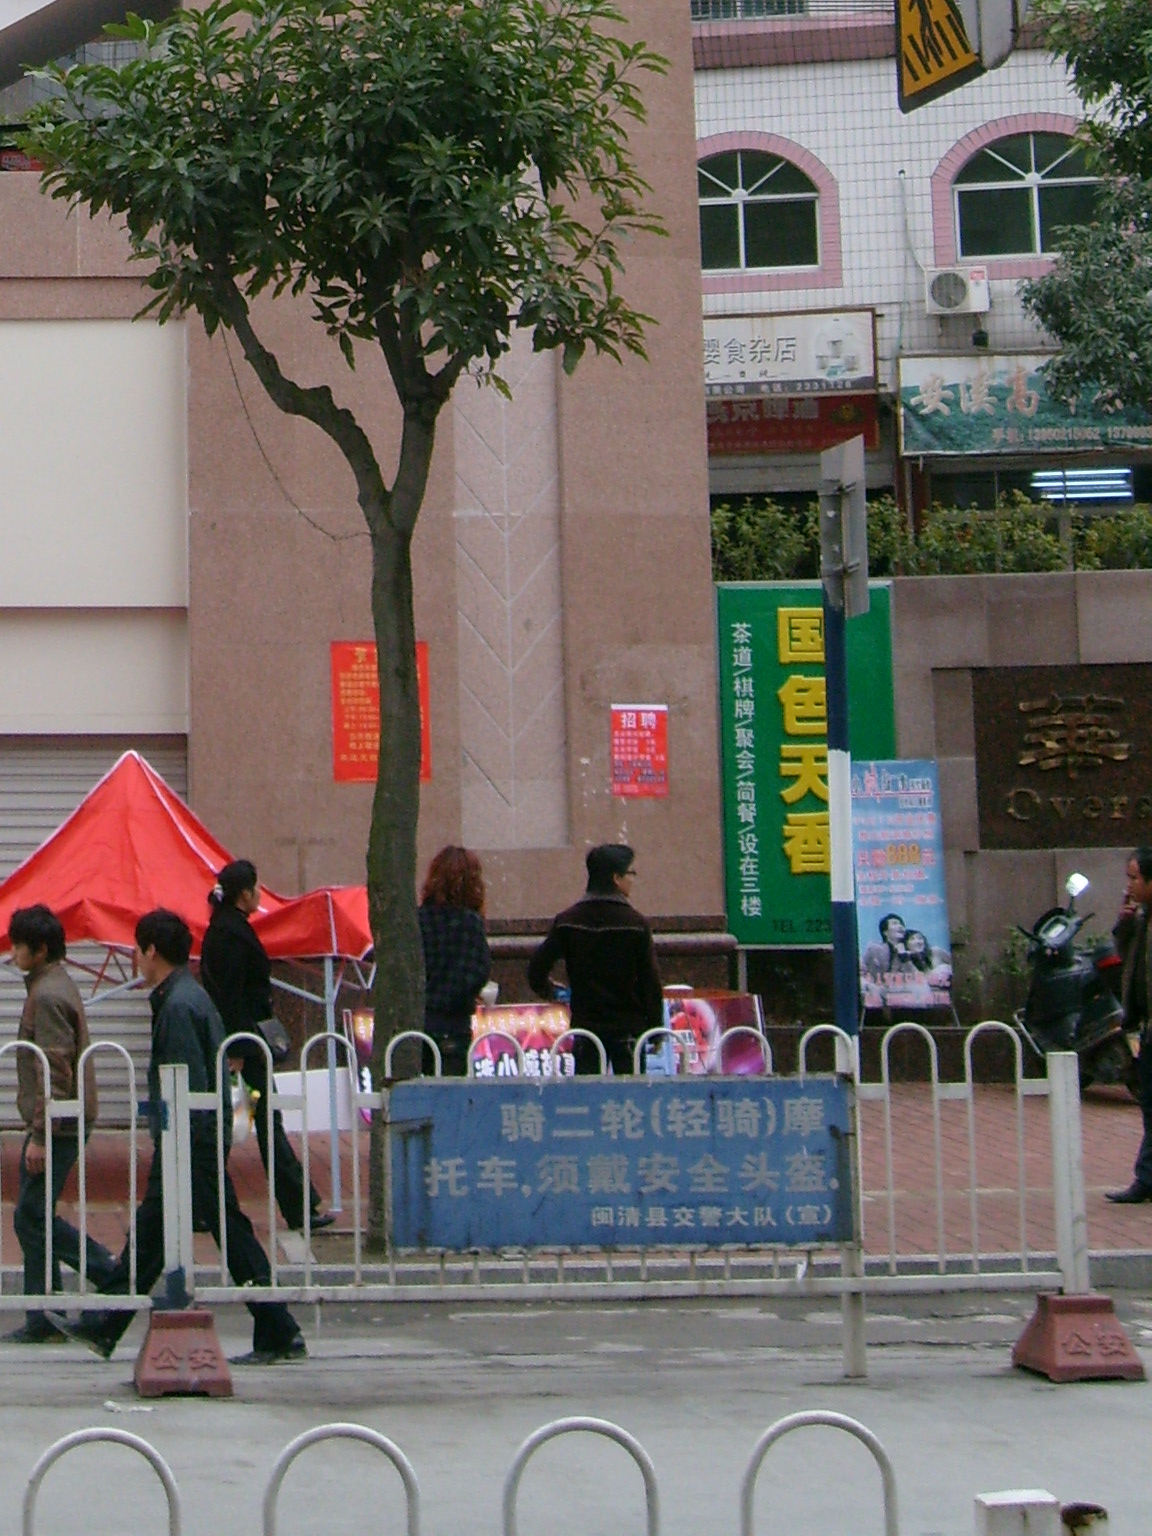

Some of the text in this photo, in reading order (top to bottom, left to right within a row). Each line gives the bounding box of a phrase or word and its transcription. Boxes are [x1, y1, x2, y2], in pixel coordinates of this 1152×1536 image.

[777, 607, 831, 877] 国色天香
[500, 1096, 826, 1143] 骑二轮(轻骑)摩
